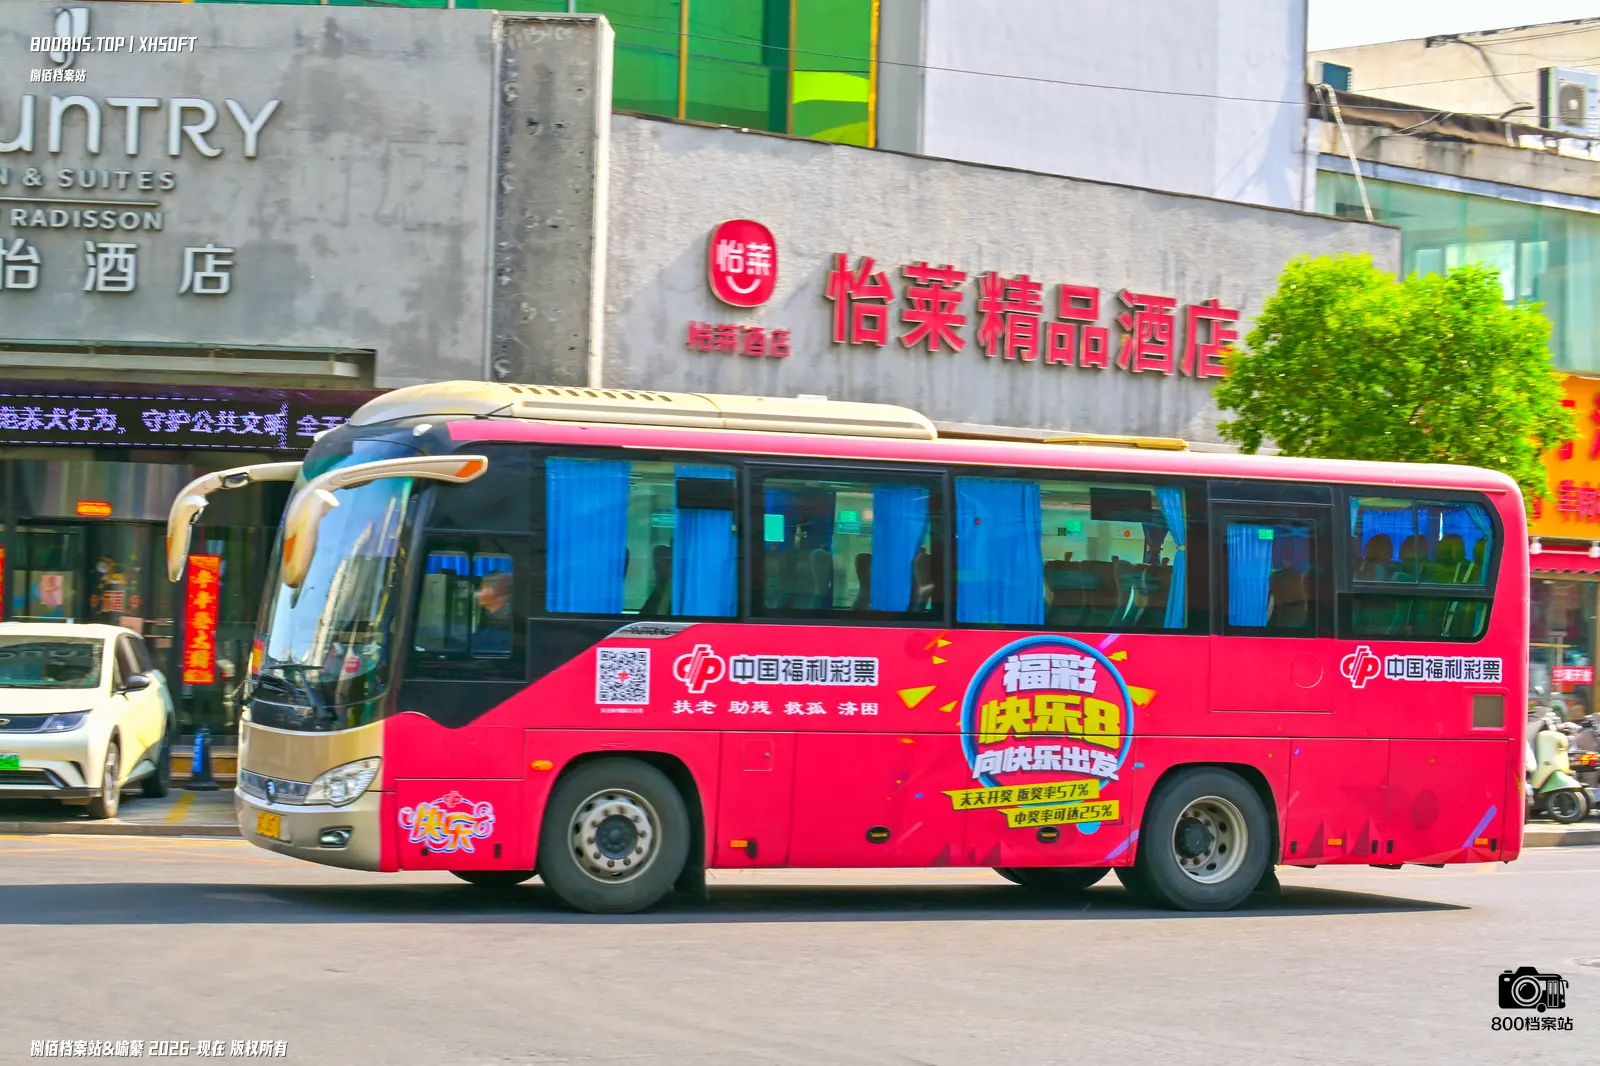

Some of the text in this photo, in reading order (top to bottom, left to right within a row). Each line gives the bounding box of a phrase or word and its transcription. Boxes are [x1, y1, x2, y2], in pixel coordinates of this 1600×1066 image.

[22, 167, 43, 187] &
[58, 168, 177, 191] SUITES
[10, 207, 164, 231] RADISSON
[716, 239, 772, 276] 怡莱
[824, 252, 1242, 379] 怡莱精品酒店
[686, 320, 792, 358] 怡莱酒店
[732, 657, 876, 684] 中国福利彩票
[1003, 653, 1097, 694] 福彩
[1386, 656, 1501, 681] 中国福利彩票
[673, 699, 879, 716] 扶老 助残 救孤 济困
[978, 694, 1121, 750] 快乐8
[971, 745, 1120, 781] 向快乐出发
[399, 801, 494, 853] 快乐
[1014, 804, 1113, 825] 中奖率可达25%
